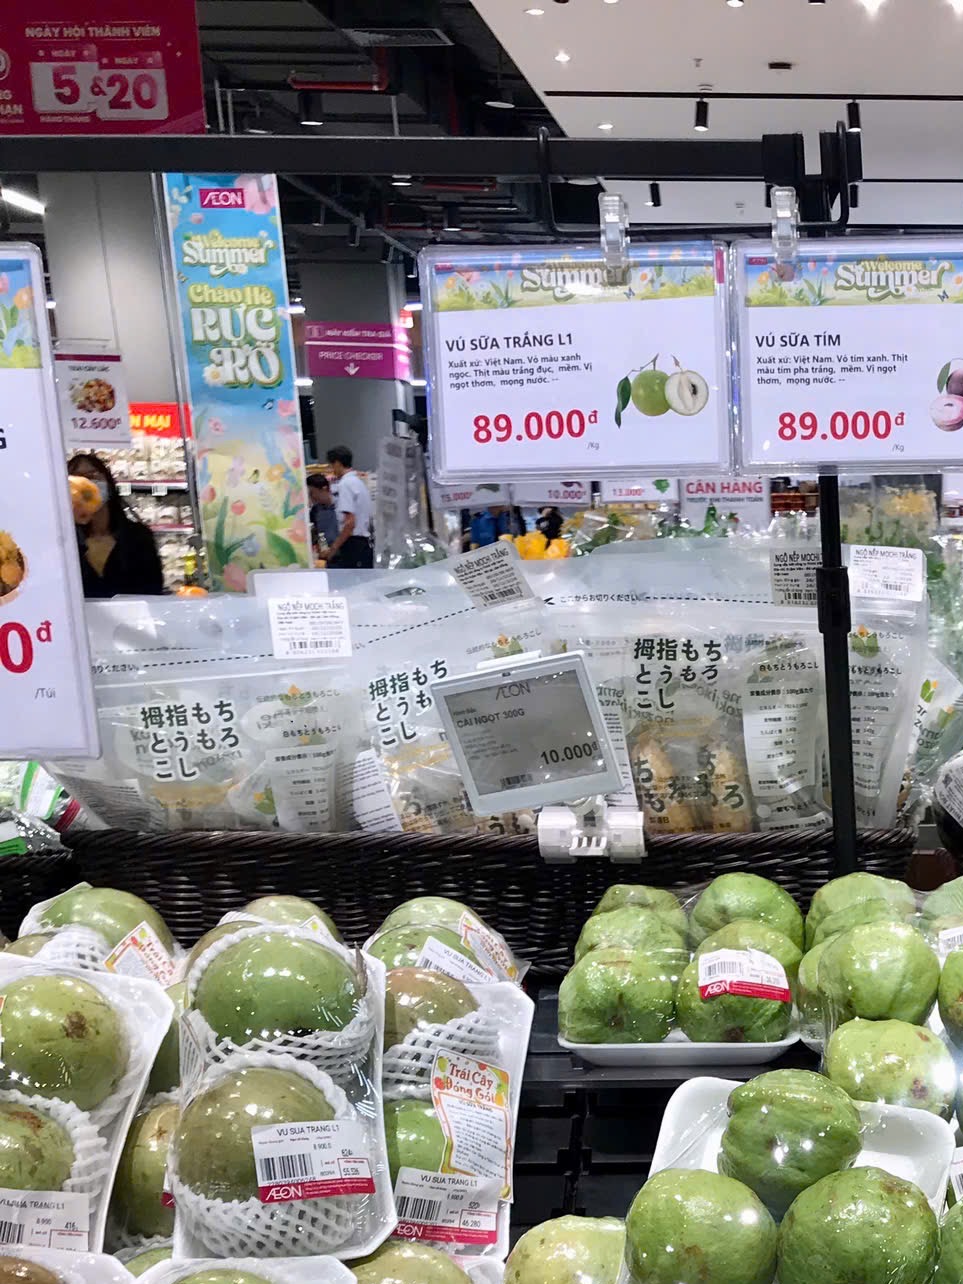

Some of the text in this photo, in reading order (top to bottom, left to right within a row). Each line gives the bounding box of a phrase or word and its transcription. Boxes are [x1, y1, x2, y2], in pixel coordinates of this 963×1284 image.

[53, 65, 158, 109] 5 & 20
[183, 240, 276, 277] Summer
[861, 257, 923, 271] Welcome
[836, 261, 952, 301] Summer
[446, 331, 573, 352] VÚ SỮA TRẮNG L1
[755, 331, 841, 347] VÚ SỮA TÍM
[473, 409, 598, 444] 89.000đ
[778, 411, 904, 441] 89.000đ
[634, 639, 722, 661] 拇指もち
[636, 665, 719, 684] とうもろ
[637, 689, 675, 710] こし
[141, 699, 236, 728] 拇指もち
[149, 726, 240, 754] とうもろ
[379, 721, 417, 745] こし
[156, 757, 197, 781] こし
[277, 1125, 340, 1136] VU SUA TRANG L1
